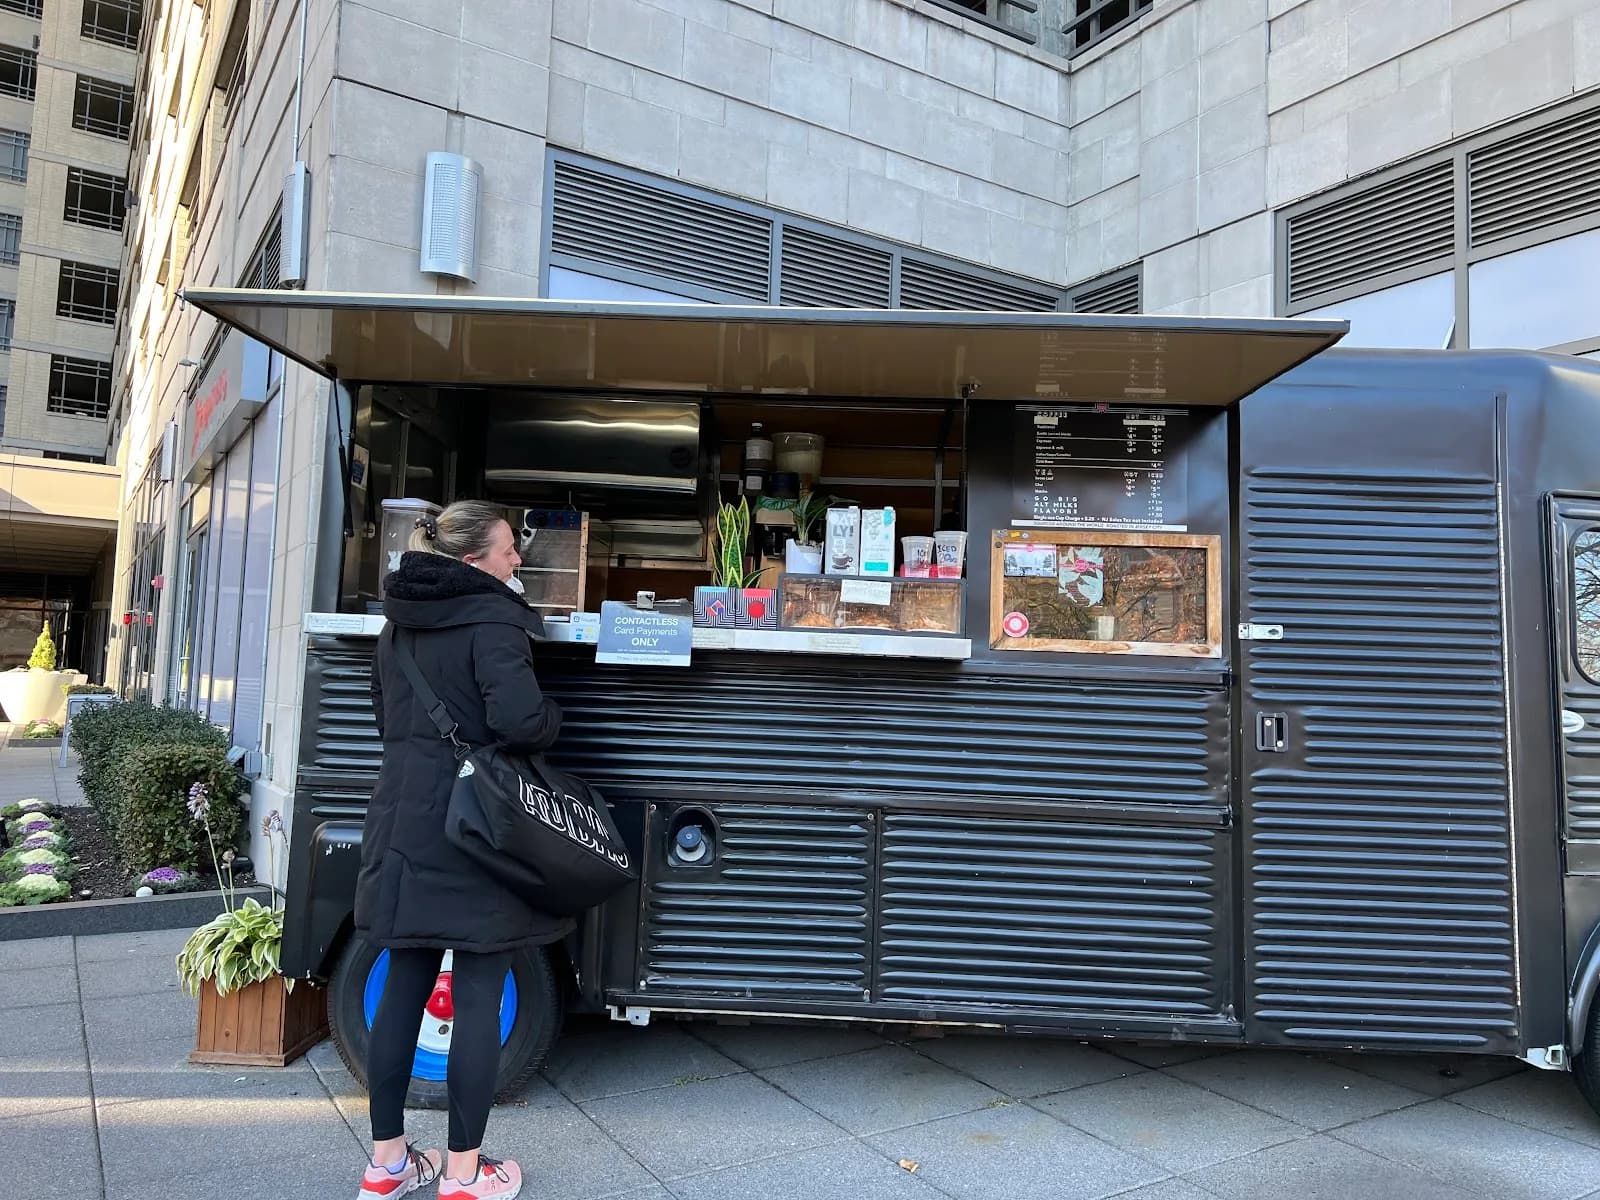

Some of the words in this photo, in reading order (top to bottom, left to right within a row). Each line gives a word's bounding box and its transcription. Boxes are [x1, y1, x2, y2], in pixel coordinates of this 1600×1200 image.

[832, 524, 854, 537] LY!
[937, 544, 957, 553] ICED
[615, 616, 679, 626] CONTACTLESS
[614, 626, 634, 635] Card
[637, 627, 678, 637] Payments
[631, 637, 659, 647] ONLY
